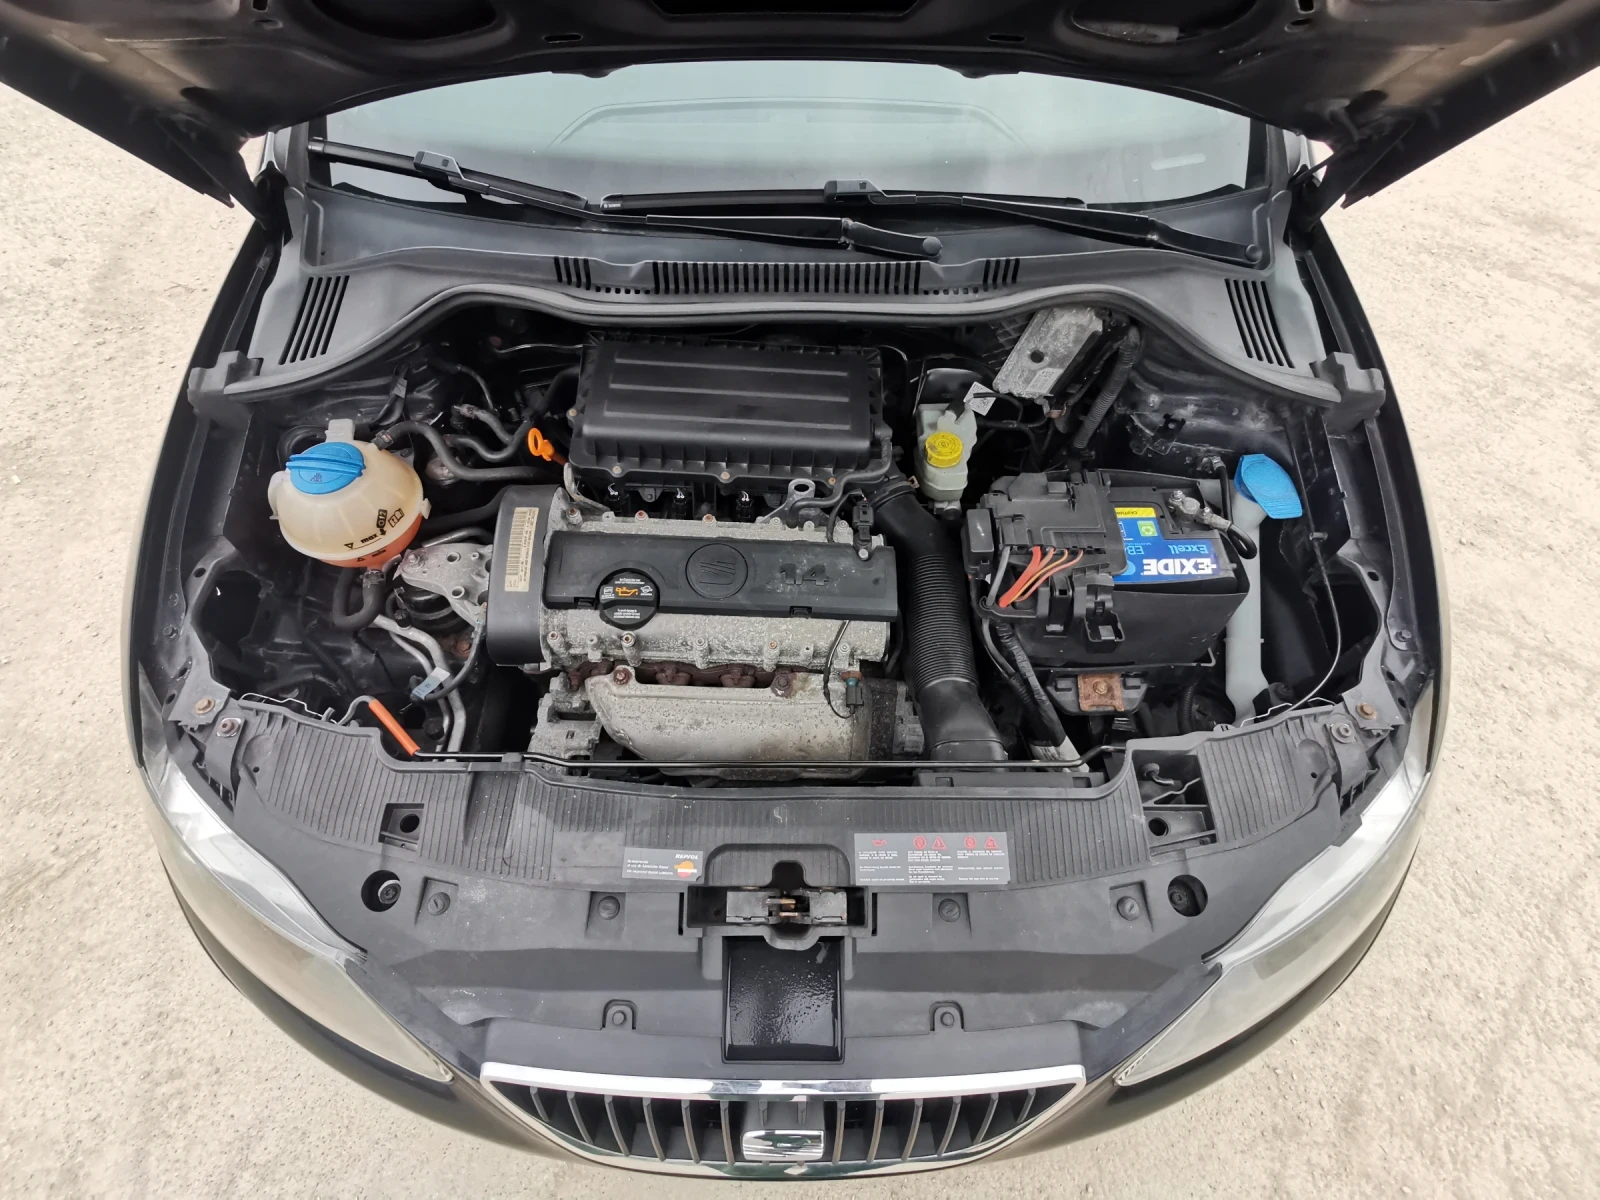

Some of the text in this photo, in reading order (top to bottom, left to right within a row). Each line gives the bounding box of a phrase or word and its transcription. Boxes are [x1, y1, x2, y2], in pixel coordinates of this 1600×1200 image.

[360, 533, 378, 544] max
[371, 549, 387, 558] min
[1124, 544, 1209, 555] Excell EB
[1142, 558, 1217, 575] EXIDE
